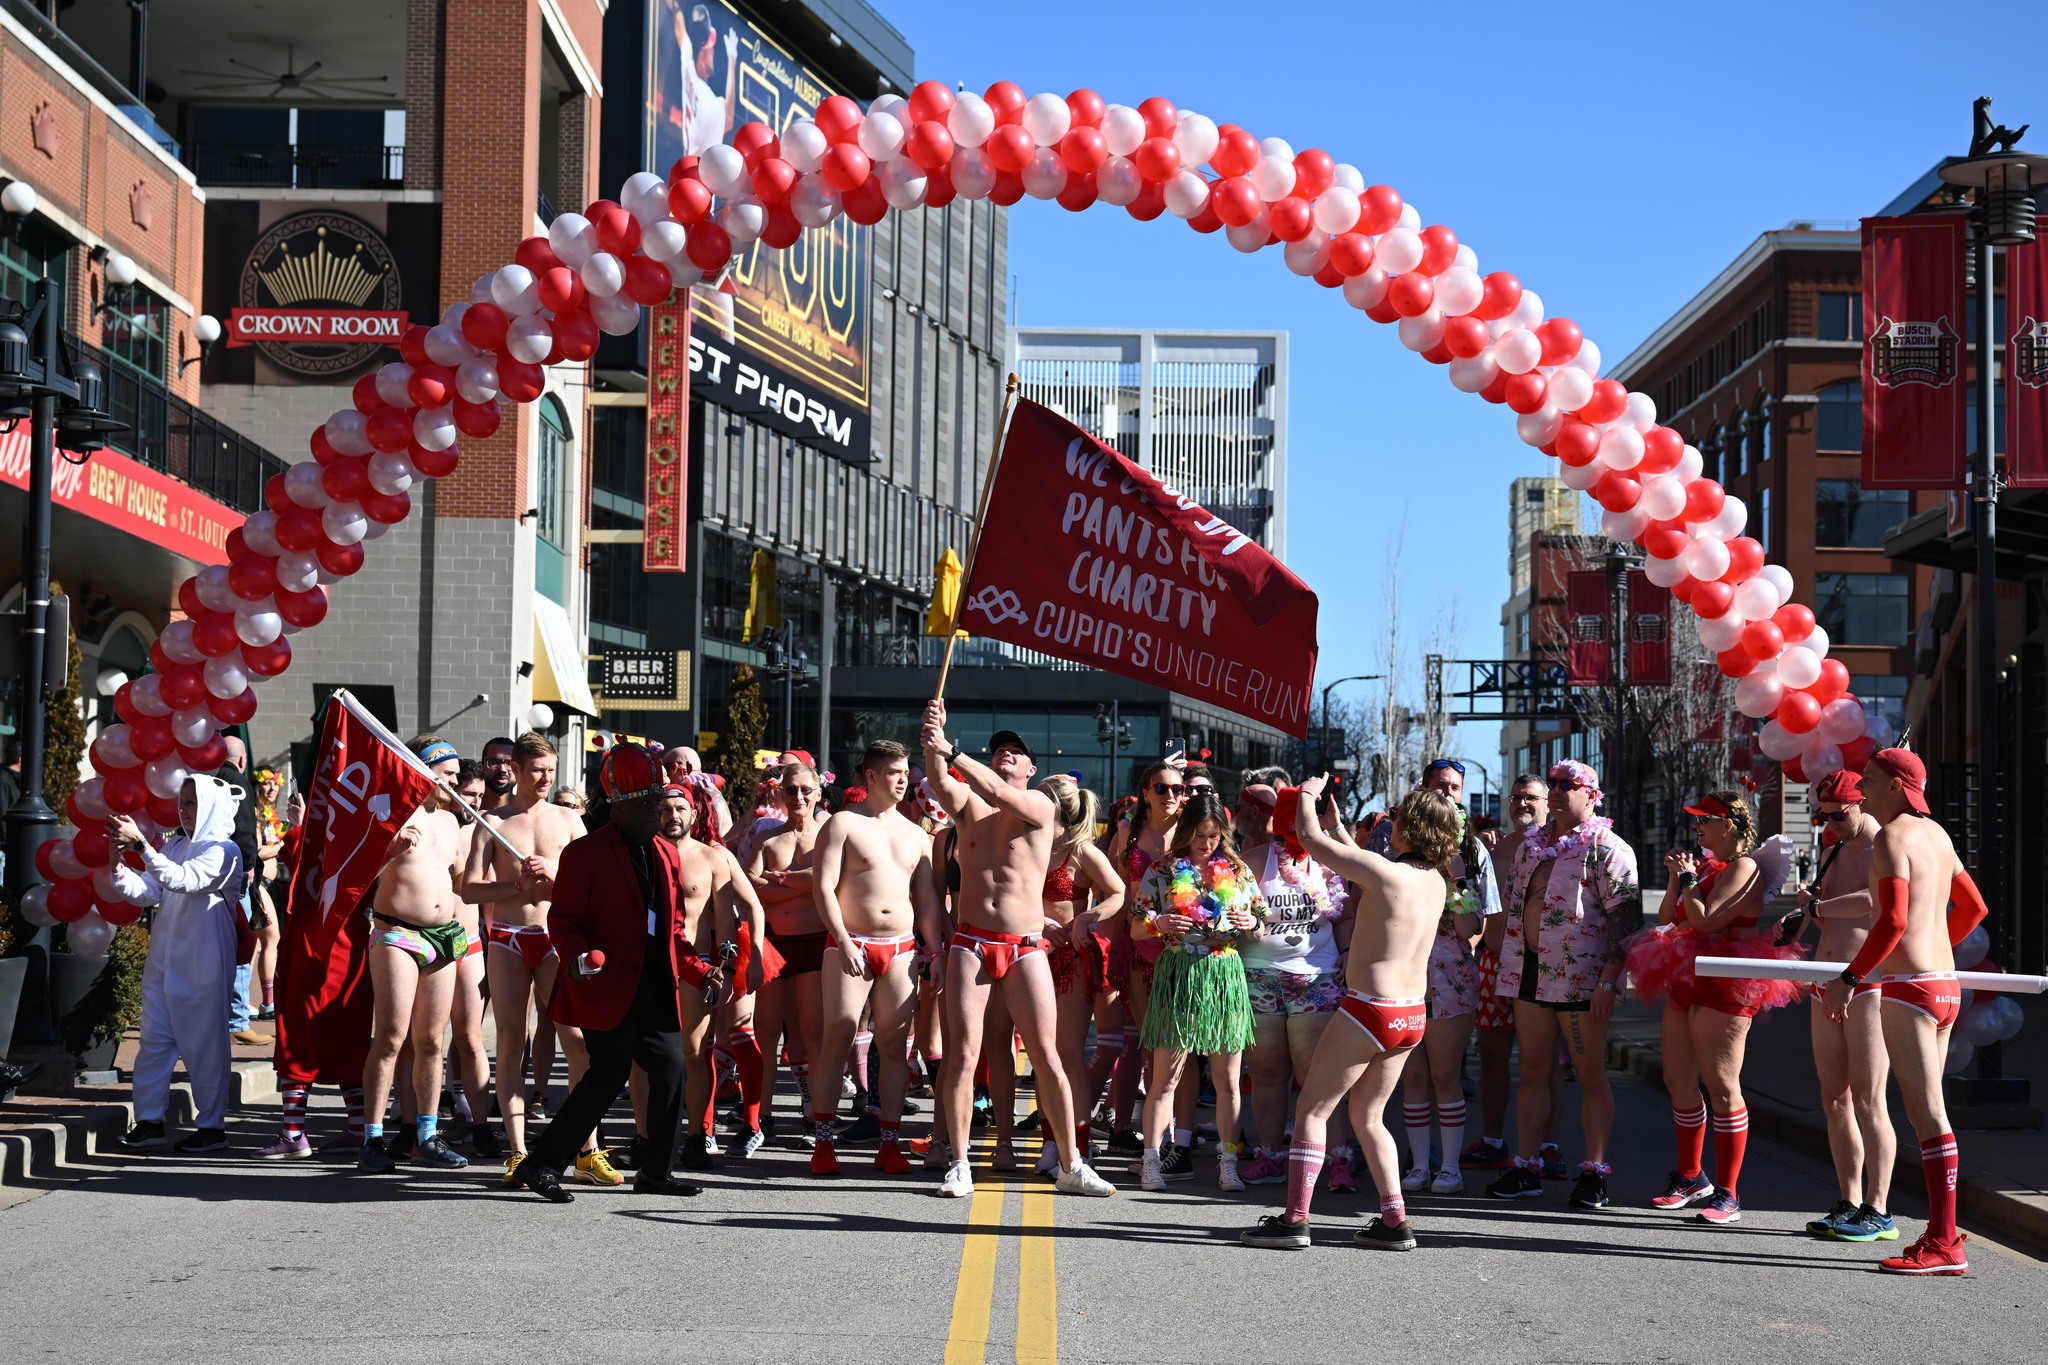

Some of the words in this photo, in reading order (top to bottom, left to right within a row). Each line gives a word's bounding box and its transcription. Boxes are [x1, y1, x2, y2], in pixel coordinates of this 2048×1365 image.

[238, 314, 323, 335] CROWN
[329, 316, 400, 337] ROOM
[761, 304, 790, 339] CAREER
[791, 321, 813, 352] HOME
[814, 334, 832, 362] RUNS
[1897, 325, 1932, 335] BUSCH
[1892, 336, 1936, 345] STADIUM
[1908, 372, 1936, 382] LOUIS
[688, 335, 731, 383] ST
[734, 363, 852, 447] PHORM
[1065, 437, 1112, 487] WE
[89, 461, 126, 508] BREW
[128, 480, 168, 527] HOUSE
[179, 506, 197, 537] ST.
[1062, 492, 1175, 565] PANTS
[1068, 550, 1218, 637] CHARITY
[1034, 600, 1152, 668] CUPID'S
[613, 660, 664, 673] BEER
[612, 675, 665, 685] GARDEN
[1267, 893, 1299, 909] YOUR
[1280, 907, 1293, 921] IS
[1295, 906, 1317, 921] MY
